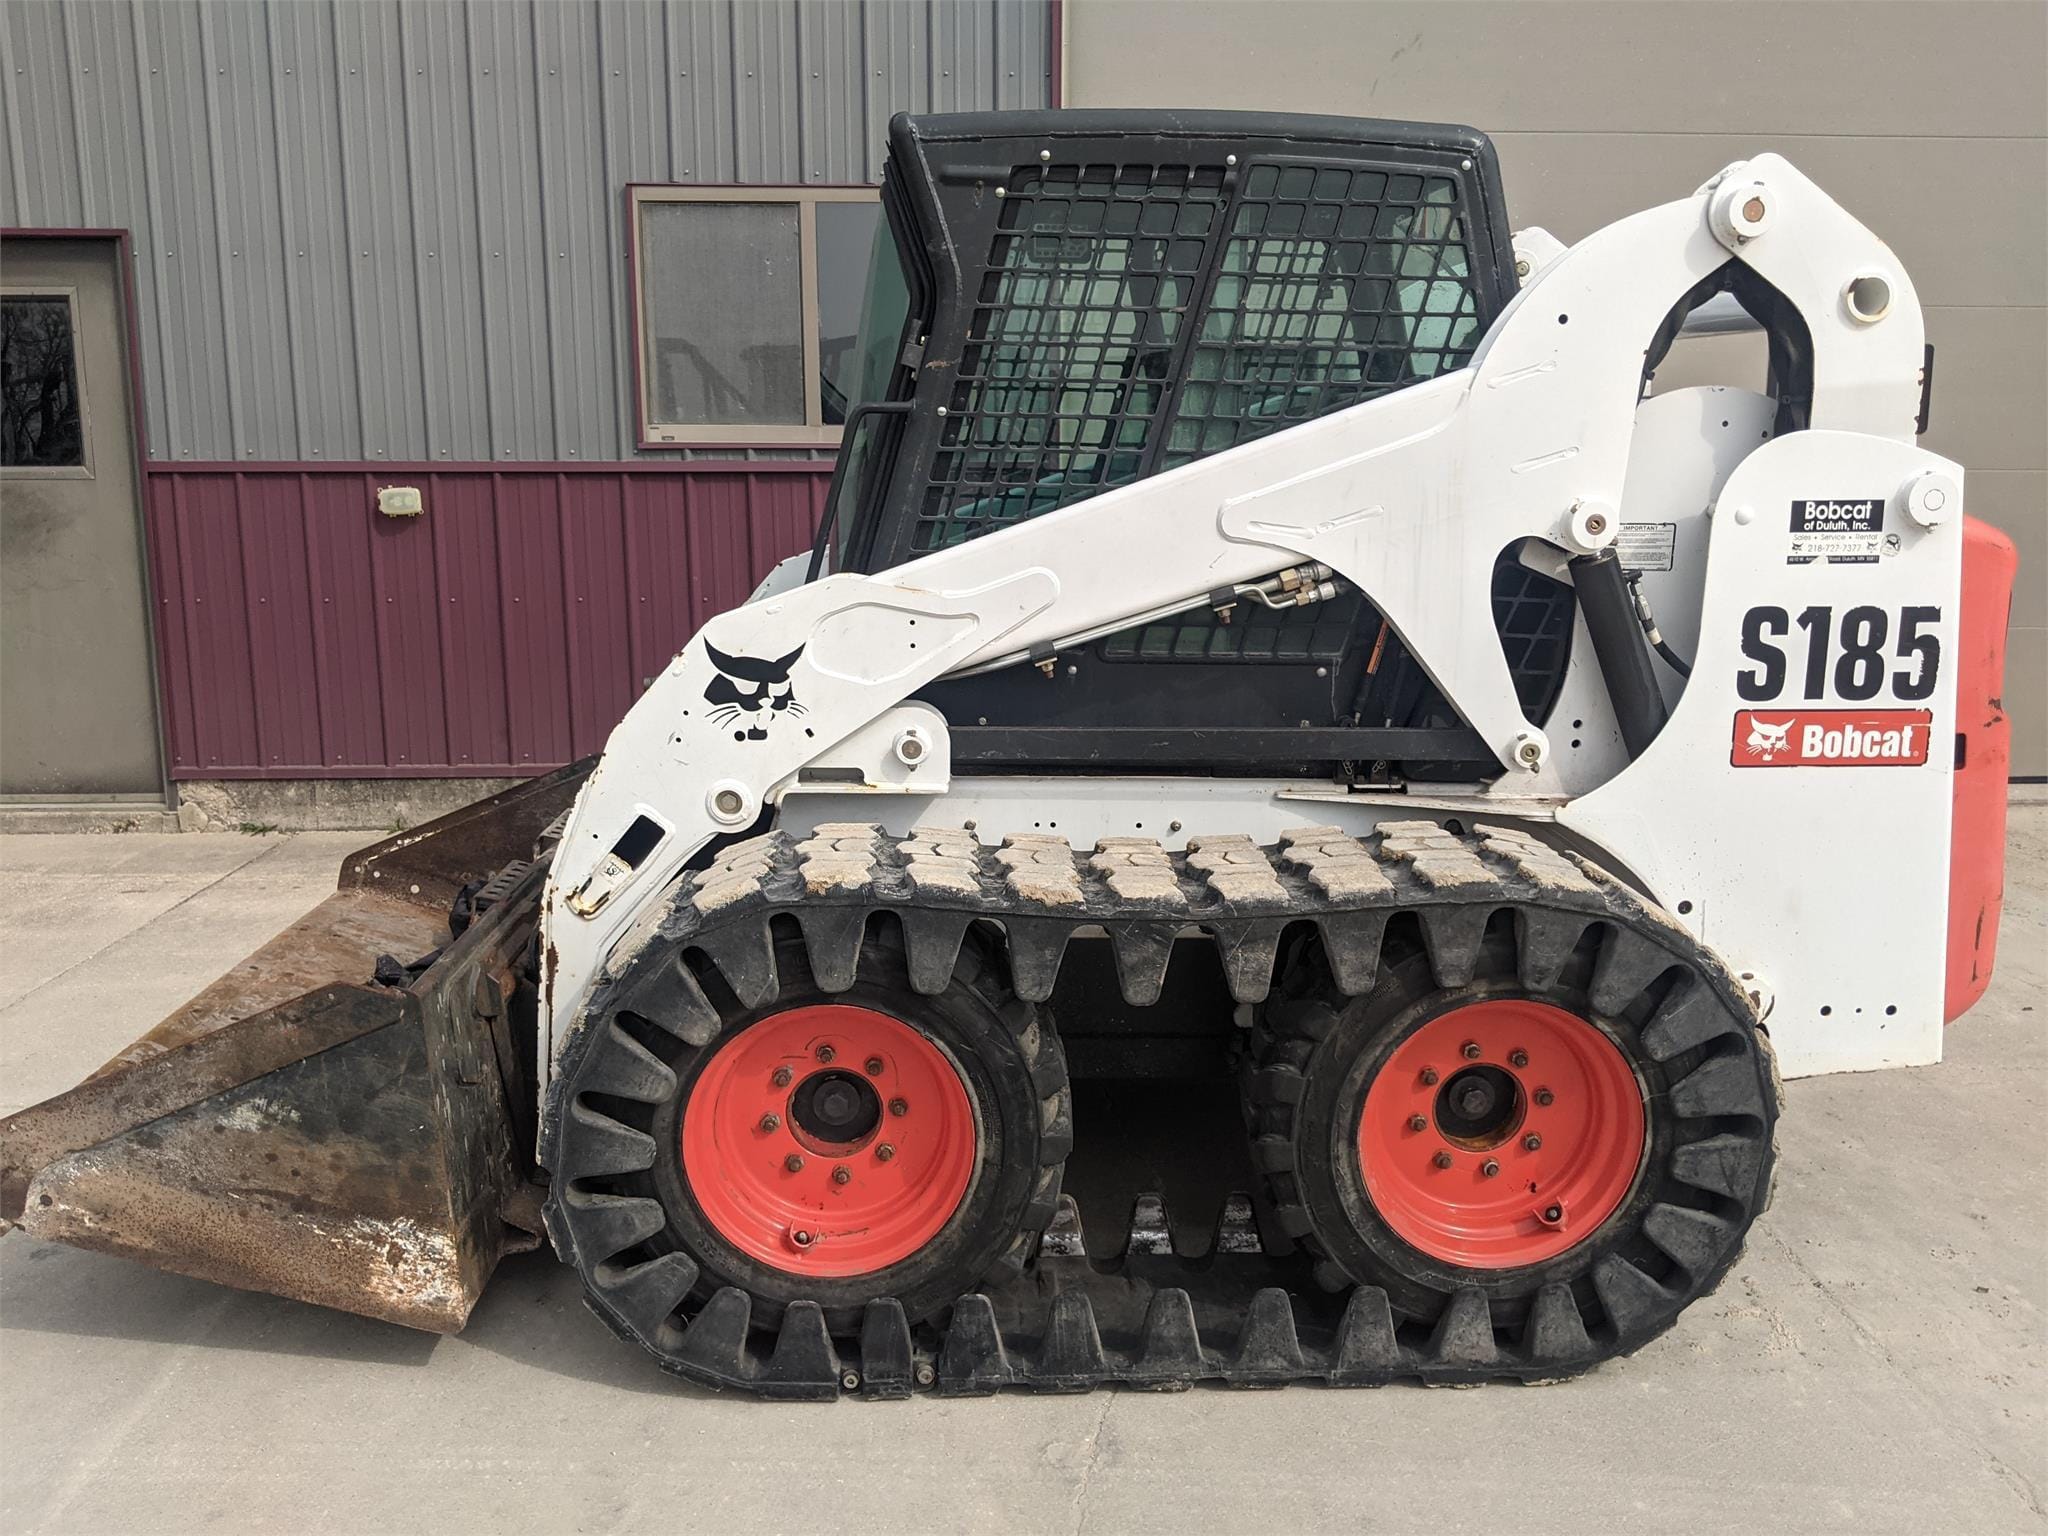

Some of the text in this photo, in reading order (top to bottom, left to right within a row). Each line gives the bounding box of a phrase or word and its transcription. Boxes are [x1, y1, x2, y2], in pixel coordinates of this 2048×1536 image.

[1804, 501, 1873, 520] Bobcat
[1803, 520, 1871, 532] of Duluth, Inc.
[1736, 605, 1941, 702] S185
[1801, 723, 1914, 759] Bobcat
